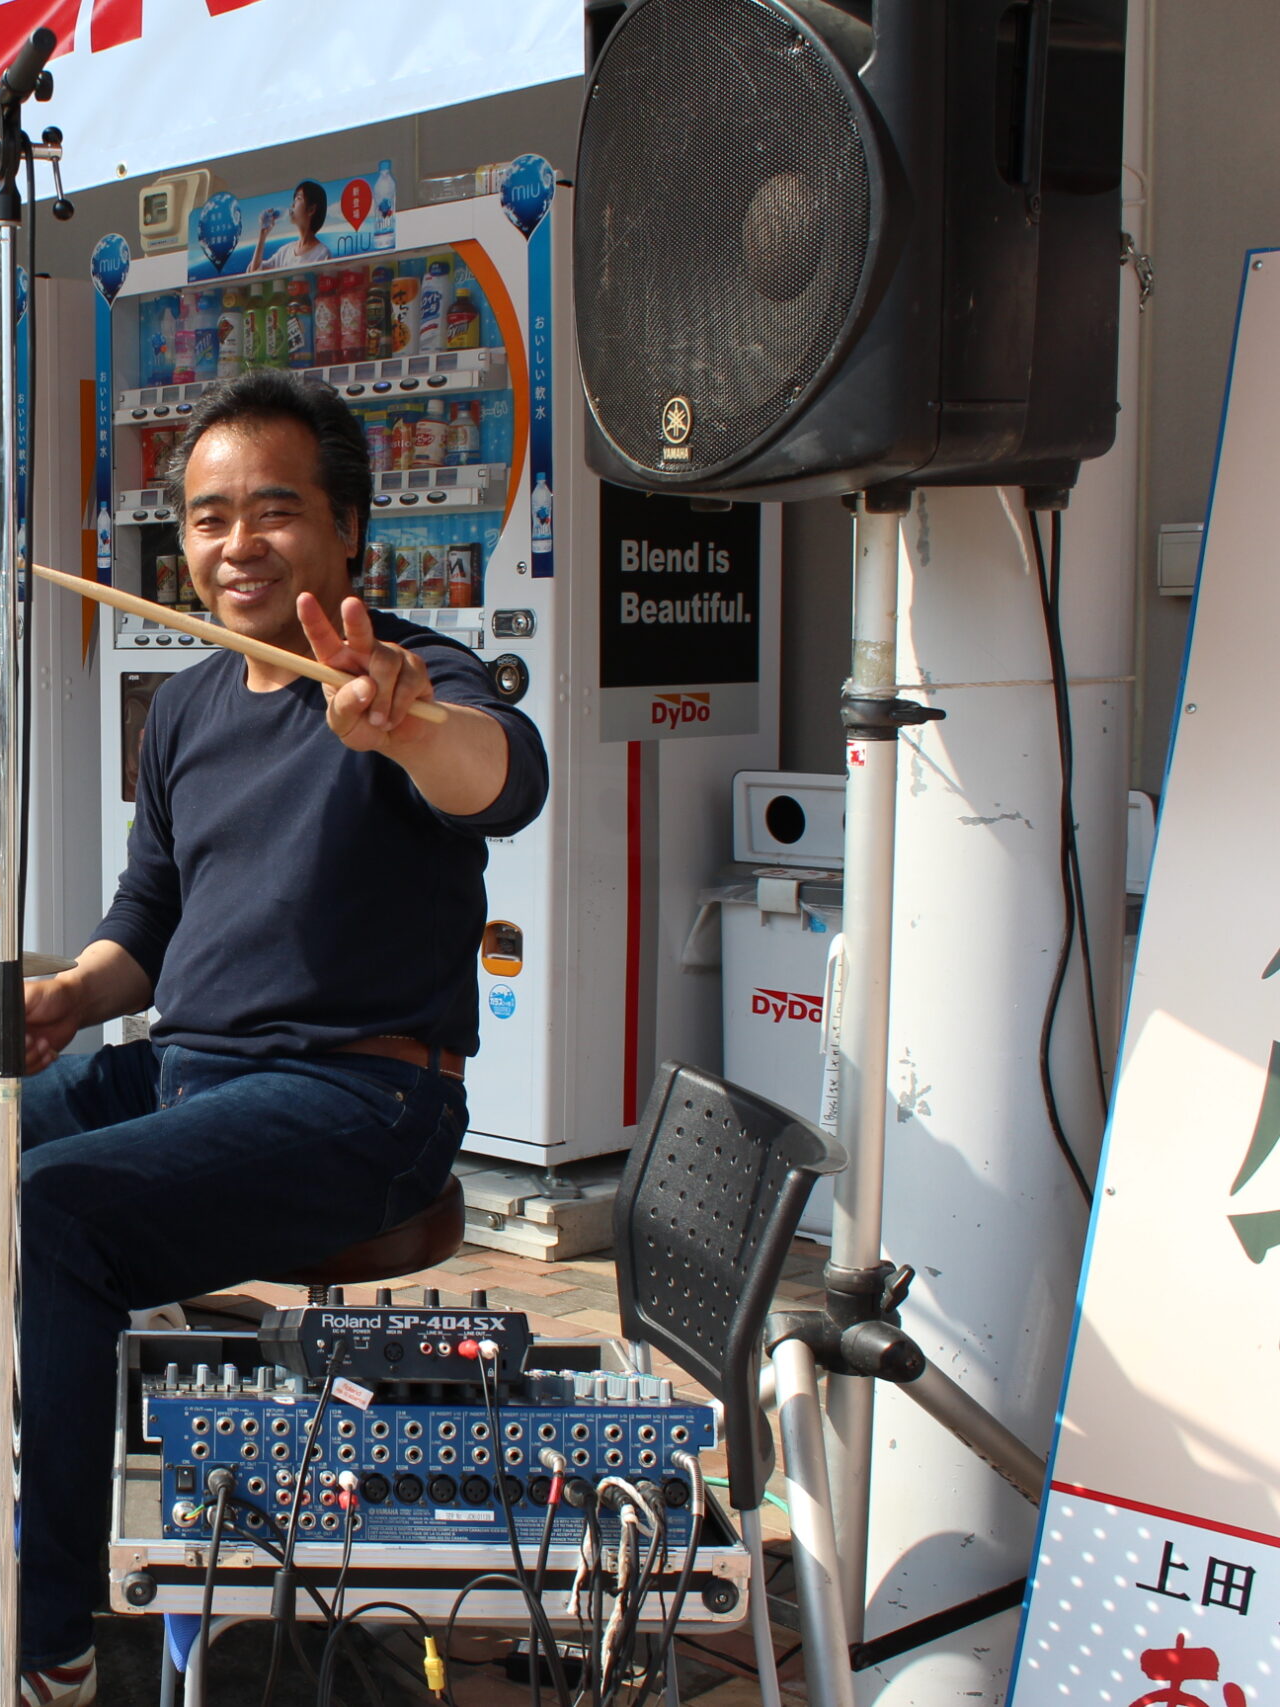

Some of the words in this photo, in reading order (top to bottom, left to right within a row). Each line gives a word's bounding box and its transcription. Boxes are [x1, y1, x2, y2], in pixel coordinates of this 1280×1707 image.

[337, 232, 371, 257] miu
[663, 446, 688, 460] YAMAHA
[621, 540, 699, 573] Blend
[708, 542, 730, 573] is
[621, 592, 751, 624] Beautiful.
[652, 701, 710, 729] DyDo
[752, 994, 823, 1023] DyDo
[321, 1314, 381, 1329] Roland
[388, 1315, 506, 1331] SP-404SX
[1136, 1540, 1257, 1616] 上田
